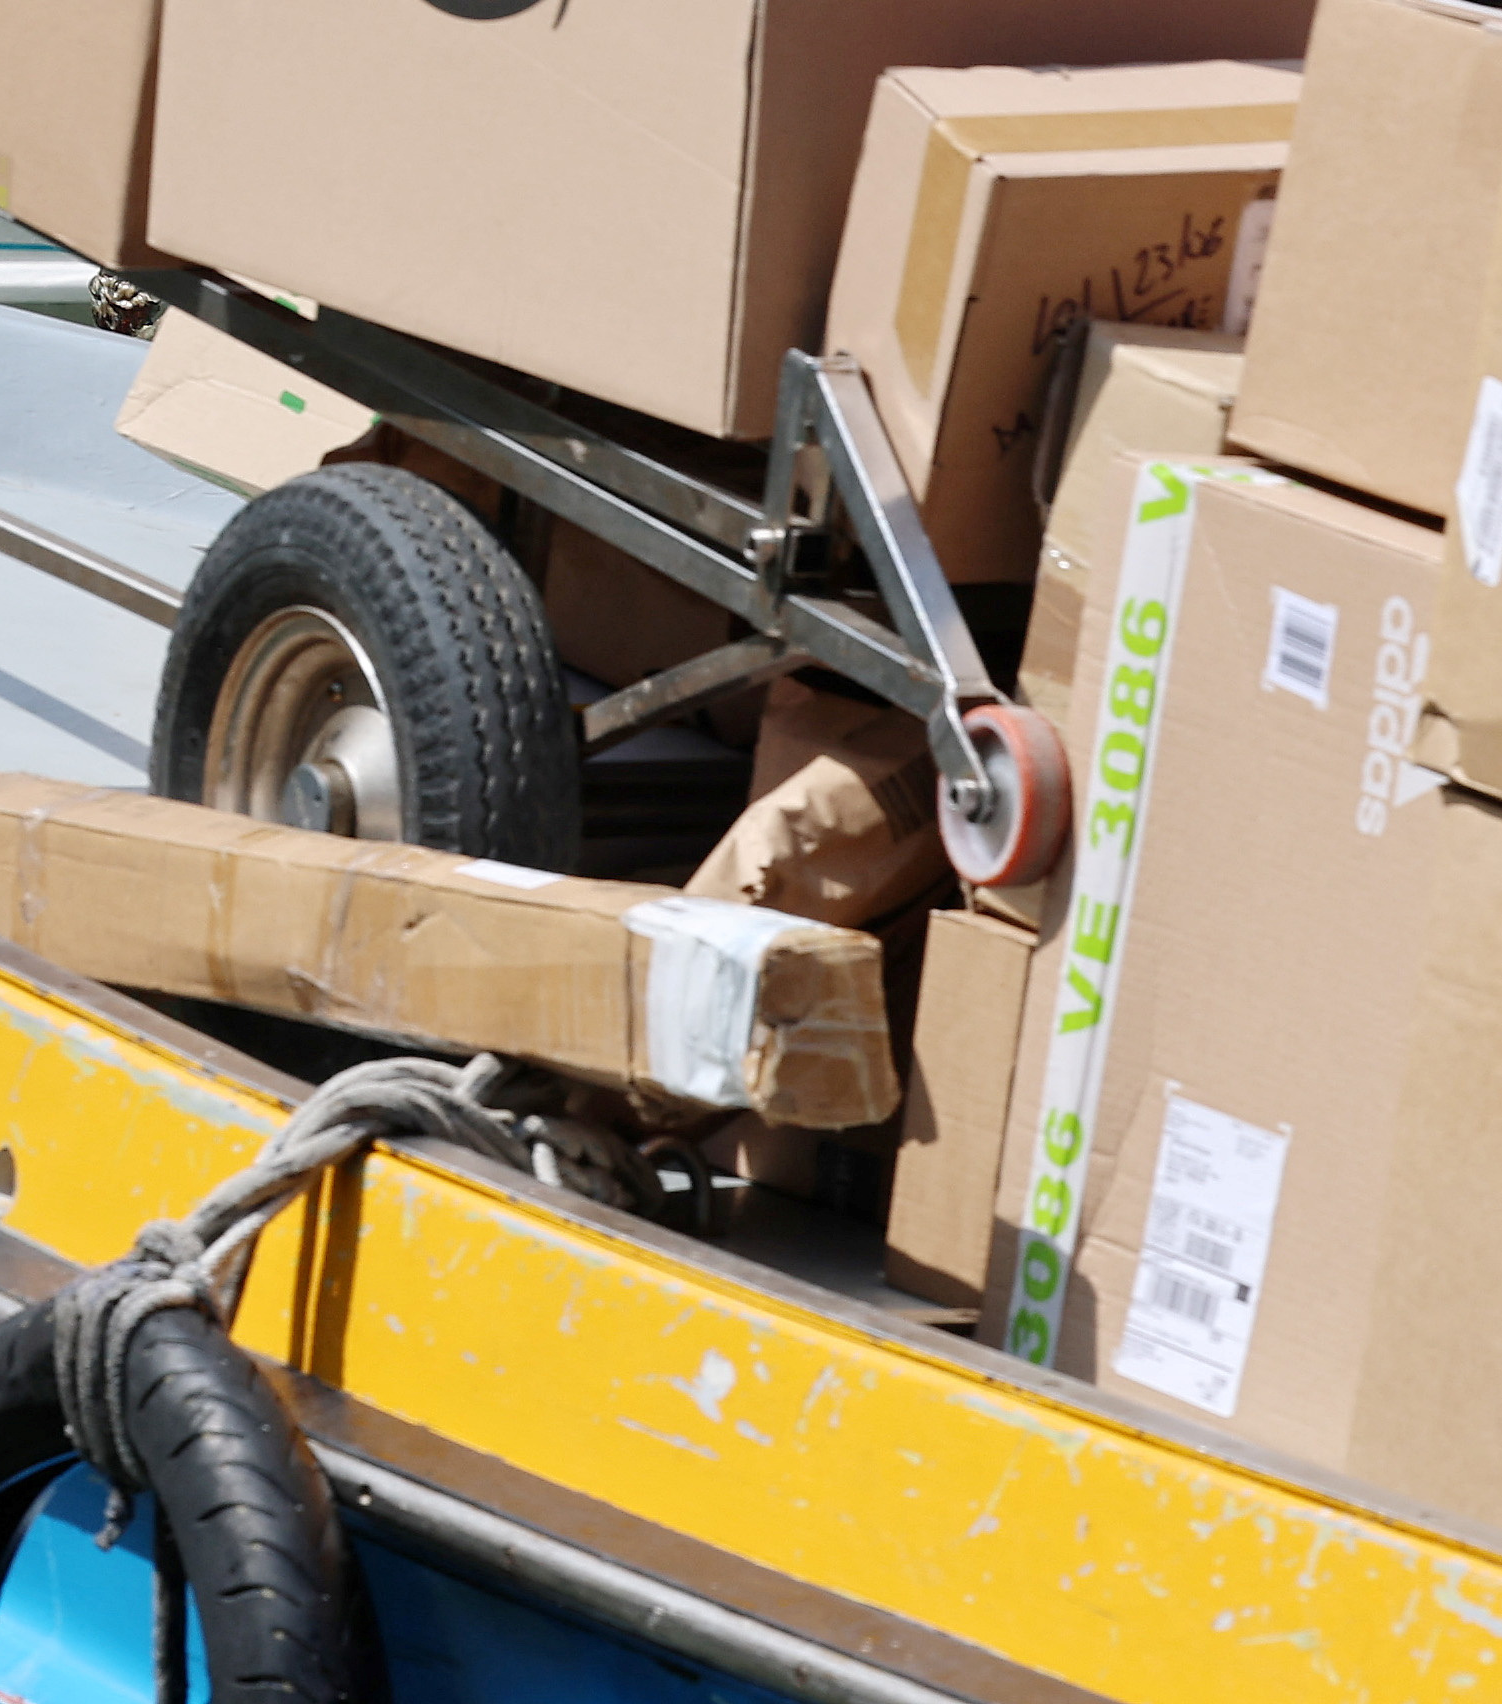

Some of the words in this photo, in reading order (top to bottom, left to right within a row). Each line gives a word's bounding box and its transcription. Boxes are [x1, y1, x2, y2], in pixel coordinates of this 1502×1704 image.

[1355, 595, 1431, 838] adidas
[1013, 1107, 1084, 1366] 3086
[1059, 893, 1121, 1035] VE
[1090, 595, 1168, 859] 3086
